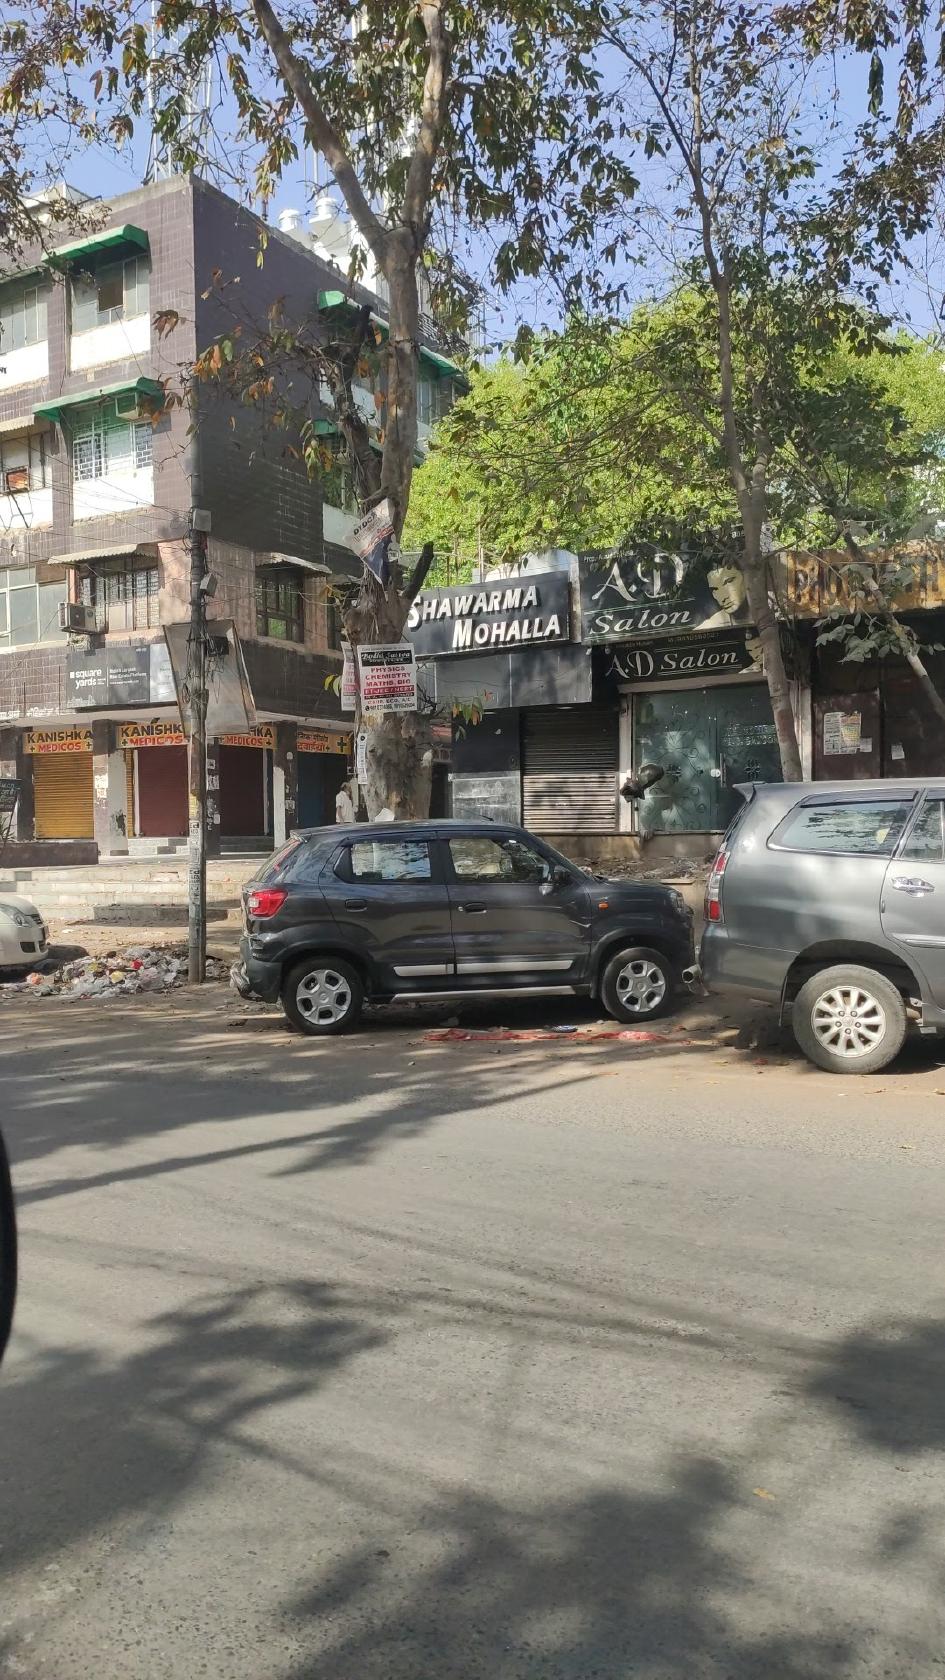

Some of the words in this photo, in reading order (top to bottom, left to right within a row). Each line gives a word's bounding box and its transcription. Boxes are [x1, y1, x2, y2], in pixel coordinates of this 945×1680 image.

[407, 585, 538, 628] SHAWARMA
[589, 609, 692, 635] Salon
[452, 614, 561, 648] MOHALLA
[661, 648, 738, 671] Salon
[75, 669, 102, 679] square
[365, 672, 411, 680] CHEMISTRY
[75, 677, 97, 689] yards
[27, 730, 93, 743] KANISHKA
[129, 735, 183, 747] MEDICOS
[226, 735, 263, 747] MEDICOS
[38, 742, 81, 752] MEDICOS
